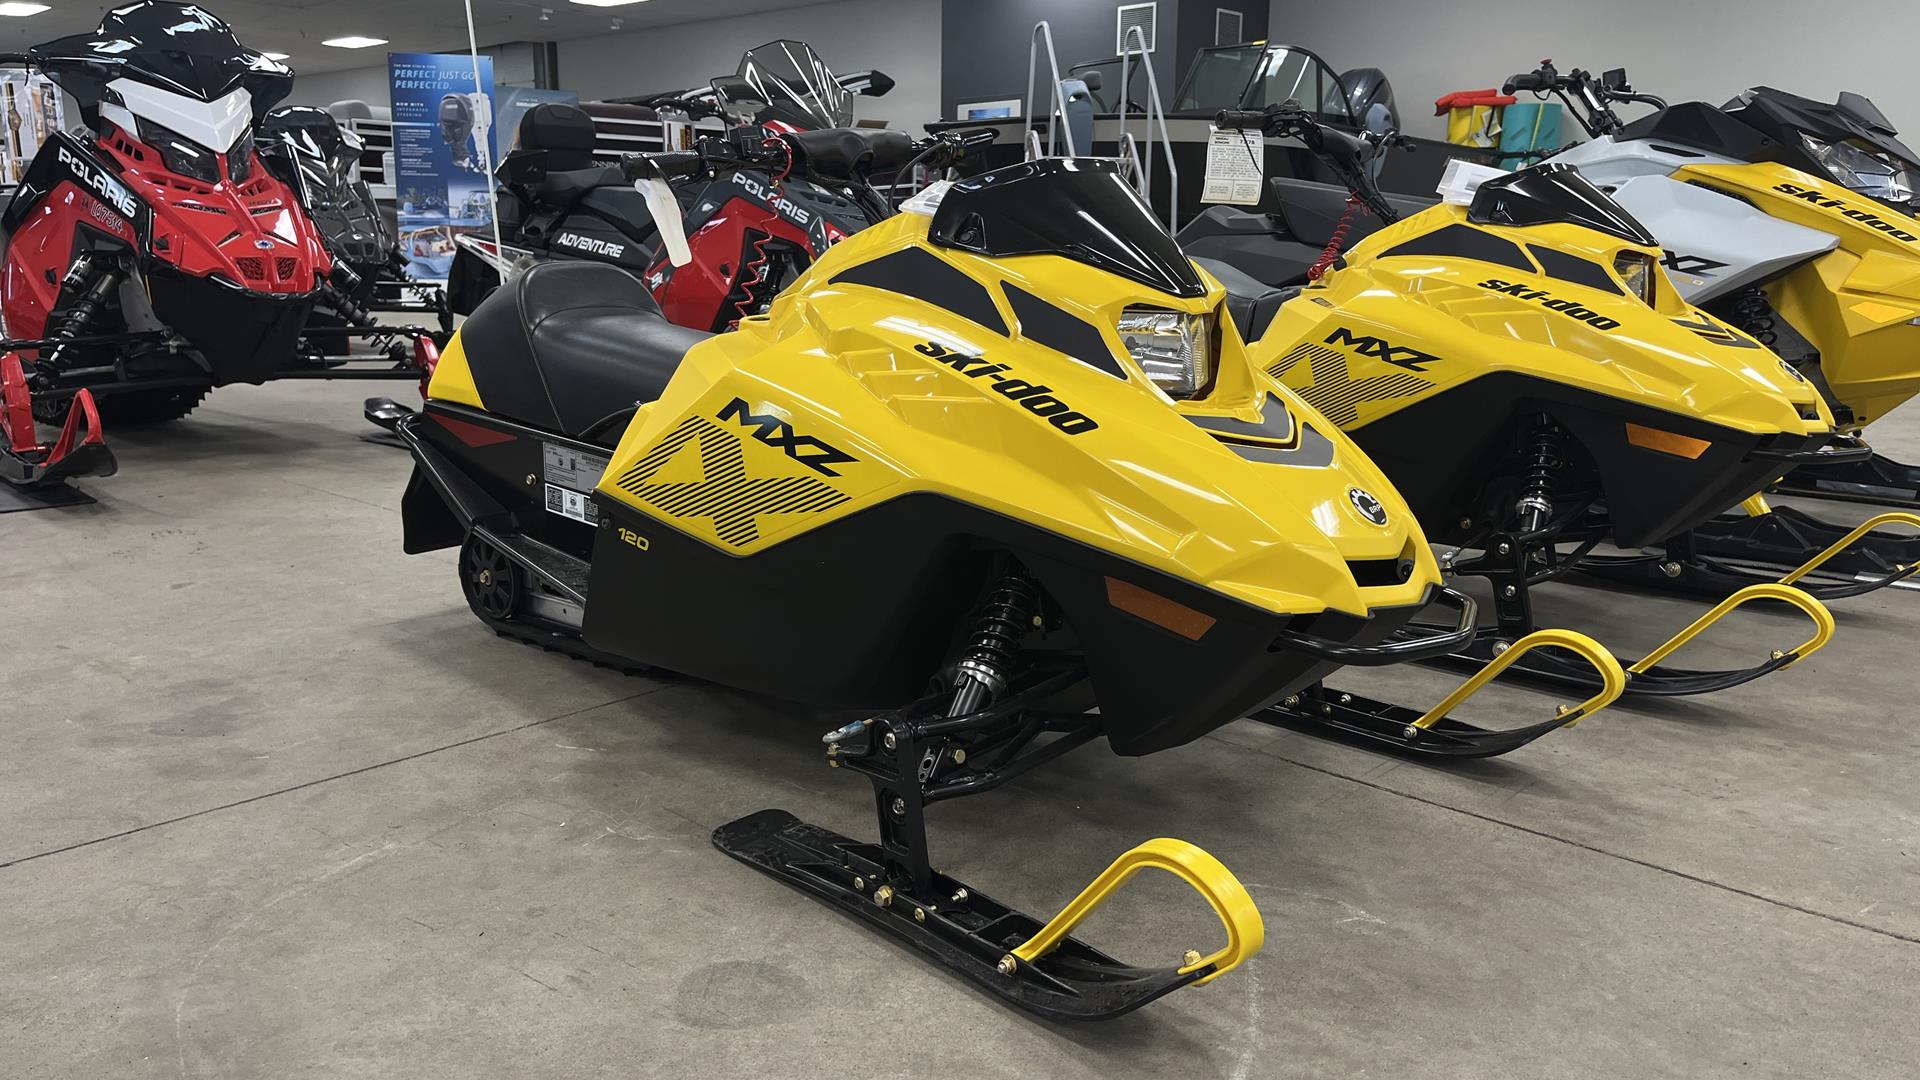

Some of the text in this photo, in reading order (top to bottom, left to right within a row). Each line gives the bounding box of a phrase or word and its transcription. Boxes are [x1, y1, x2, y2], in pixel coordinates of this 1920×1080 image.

[394, 69, 436, 79] PERFECT
[438, 71, 458, 81] JUST
[395, 80, 453, 90] PERFECTED.
[58, 146, 137, 218] POLARIS
[732, 172, 810, 224] POLARIS
[557, 232, 624, 258] ADVENTURE
[1659, 249, 1731, 277] XZ
[1323, 327, 1443, 372] MXZ
[715, 396, 861, 477] MXZ
[618, 527, 650, 551] 120
